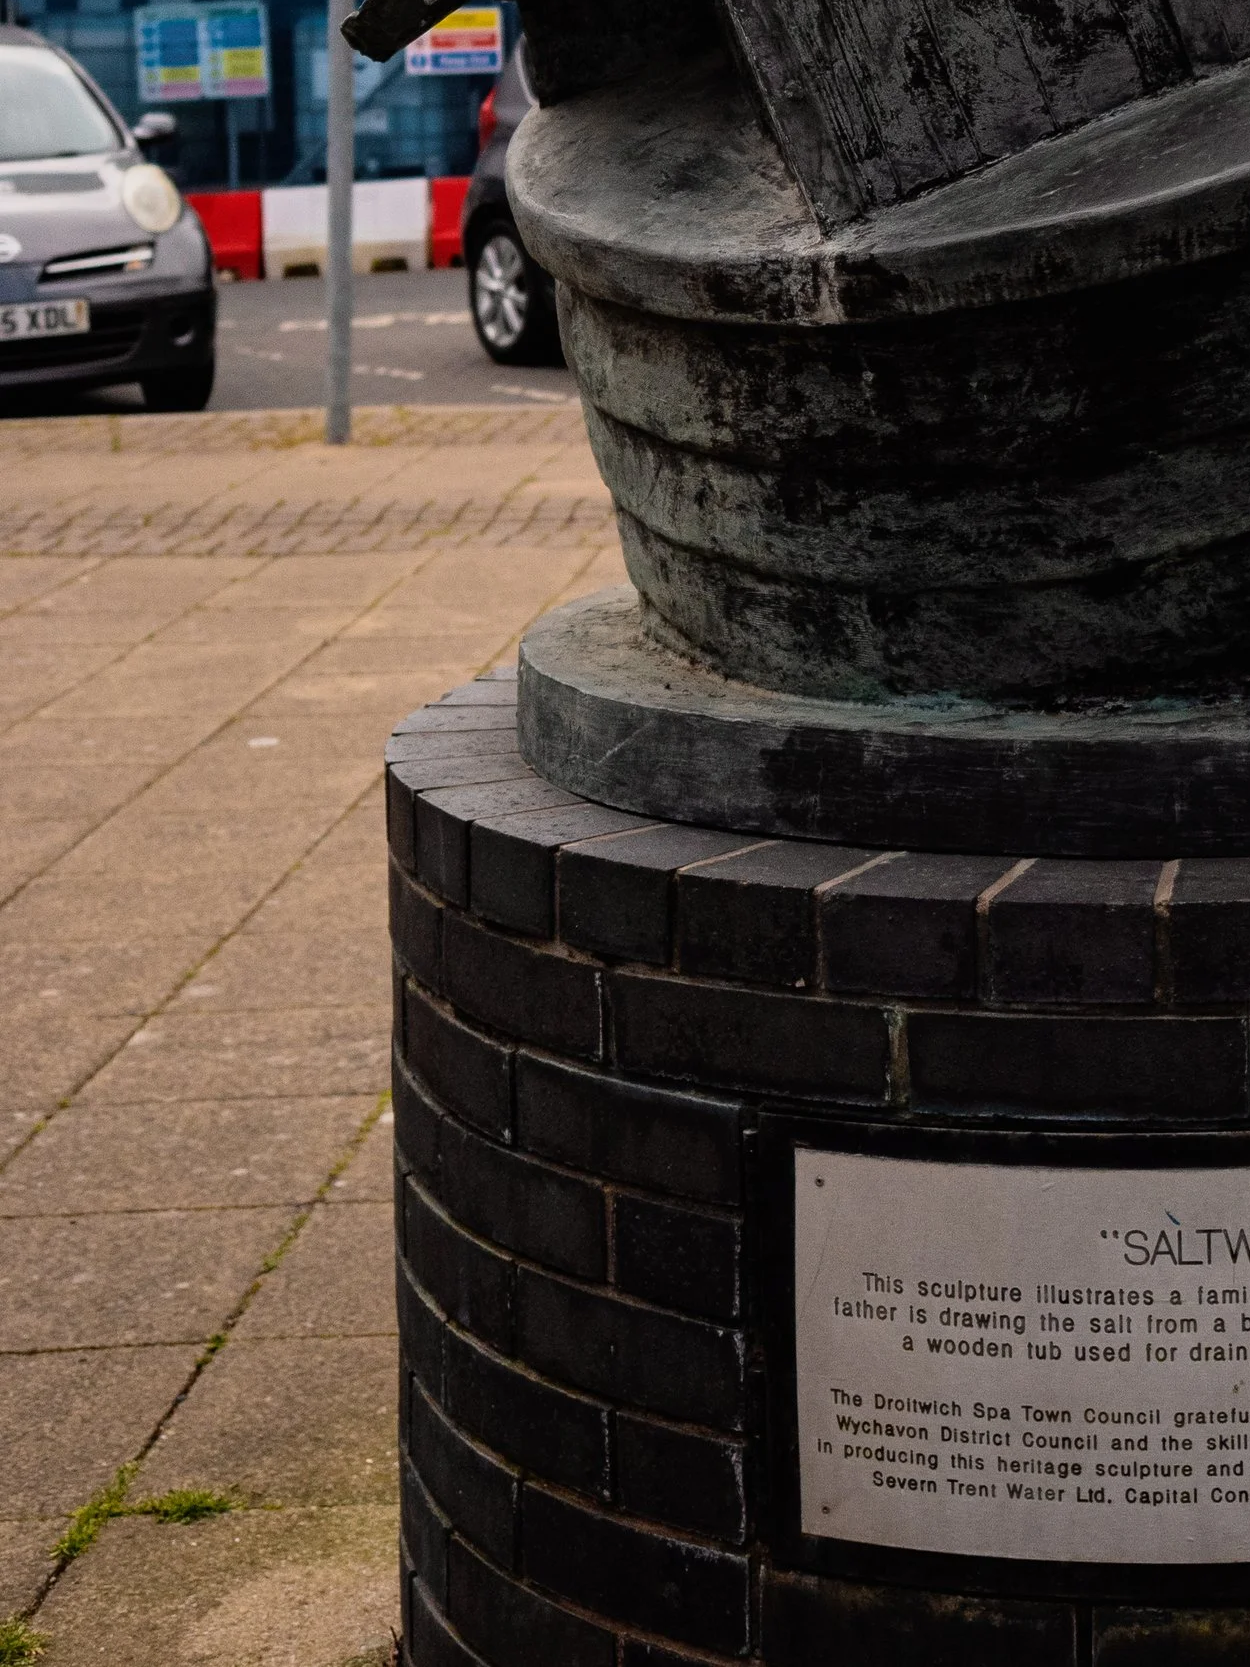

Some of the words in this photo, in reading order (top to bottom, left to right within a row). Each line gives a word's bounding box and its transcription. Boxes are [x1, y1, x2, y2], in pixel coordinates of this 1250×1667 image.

[861, 1271, 904, 1295] This
[917, 1279, 1022, 1303] sculpture
[1036, 1284, 1155, 1306] illustrates
[1169, 1289, 1183, 1306] a
[834, 1296, 898, 1322] father
[909, 1305, 928, 1325] is
[939, 1306, 1026, 1336] drawing
[1039, 1312, 1075, 1333] the
[1089, 1314, 1132, 1334] salt
[1147, 1314, 1198, 1335] from
[1213, 1317, 1227, 1333] a
[902, 1335, 914, 1352] a
[926, 1337, 1013, 1359] wooden
[1027, 1340, 1062, 1361] tub
[1074, 1342, 1131, 1363] used
[1145, 1342, 1178, 1363] for
[829, 1387, 863, 1408] The
[873, 1393, 962, 1417] Droitwich
[972, 1401, 1012, 1422] Spa
[1020, 1404, 1072, 1424] Town
[1083, 1407, 1161, 1426] Council
[836, 1414, 929, 1441] Wychavon
[940, 1425, 1011, 1447] District
[1021, 1431, 1098, 1451] Council
[1110, 1434, 1149, 1452] and
[1160, 1435, 1193, 1452] the
[1206, 1433, 1248, 1451] skill
[817, 1438, 833, 1454] in
[843, 1444, 939, 1471] producing
[950, 1453, 985, 1471] this
[997, 1455, 1083, 1480] heritage
[1095, 1460, 1193, 1480] sculpture
[1206, 1460, 1245, 1477] and
[872, 1470, 938, 1494] Severn
[946, 1478, 997, 1498] Trent
[1006, 1482, 1066, 1502] Water
[1124, 1487, 1198, 1507] Capital
